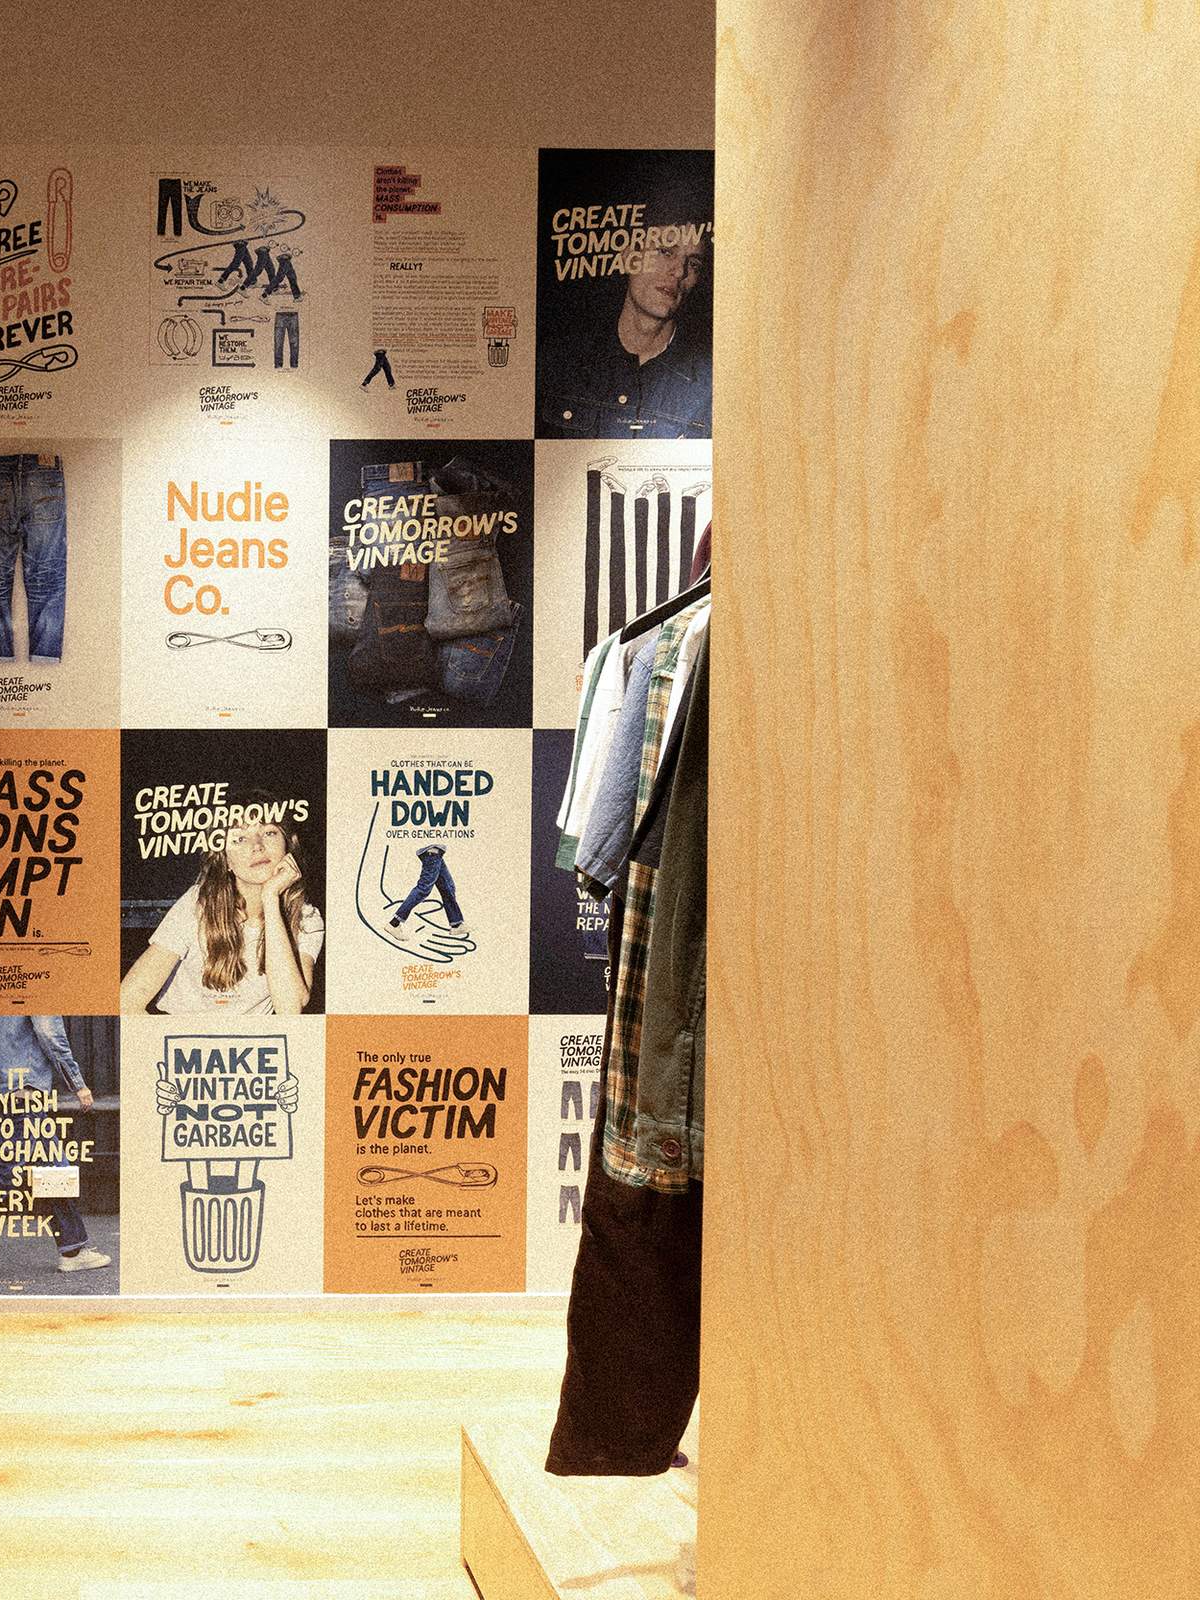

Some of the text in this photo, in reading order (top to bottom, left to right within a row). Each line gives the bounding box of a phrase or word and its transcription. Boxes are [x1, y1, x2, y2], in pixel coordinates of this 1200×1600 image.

[375, 204, 438, 212] CONSUMPTION
[552, 205, 646, 233] CREATE
[551, 221, 714, 258] TOMORROW'
[390, 262, 423, 271] REALLY?
[554, 250, 657, 281] VINTAGE
[0, 258, 40, 291] RE-
[2, 277, 72, 321] PAIRS
[200, 386, 231, 395] CREATE
[407, 388, 438, 397] CREATE
[200, 402, 235, 411] VINTAGE
[407, 404, 442, 414] VINTAGE
[166, 481, 288, 522] Nudie
[343, 494, 438, 524] CREATE
[343, 511, 518, 546] TOMORROW'S
[164, 528, 288, 568] Jeans
[347, 540, 449, 570] VINTAGE
[164, 574, 229, 615] Co.
[0, 758, 22, 767] killing
[40, 759, 67, 767] planet.
[391, 760, 424, 768] CLOTHES
[371, 770, 494, 796] HANDED
[135, 783, 229, 812] CREATE
[134, 799, 309, 835] TOMORROW'S
[391, 800, 469, 827] DOWN
[386, 830, 475, 839] OVER GENERATIONS
[577, 903, 600, 914] THE
[33, 928, 44, 938] is.
[402, 964, 433, 974] CREATE
[403, 981, 437, 990] VINTAGE
[560, 1035, 603, 1046] CREATE
[357, 1052, 431, 1064] The only true
[560, 1046, 602, 1057] TOMOR
[174, 1048, 278, 1074] MAKE
[560, 1056, 600, 1067] VINTAG
[8, 1068, 30, 1089] IT
[353, 1067, 507, 1102] FASHION
[175, 1076, 277, 1100] VINTAGE
[175, 1104, 277, 1121] NOT
[23, 1117, 73, 1139] NOT
[354, 1104, 496, 1140] VICTIM
[174, 1123, 277, 1147] GARBAGE
[0, 1141, 94, 1162] CHANGE
[357, 1143, 431, 1155] is the planet.
[356, 1195, 415, 1206] Let's make
[355, 1207, 481, 1218] clothes that are meant
[355, 1221, 448, 1231] to last a lifetime.
[399, 1248, 431, 1258] CREATE
[400, 1264, 435, 1274] VINTAGE
